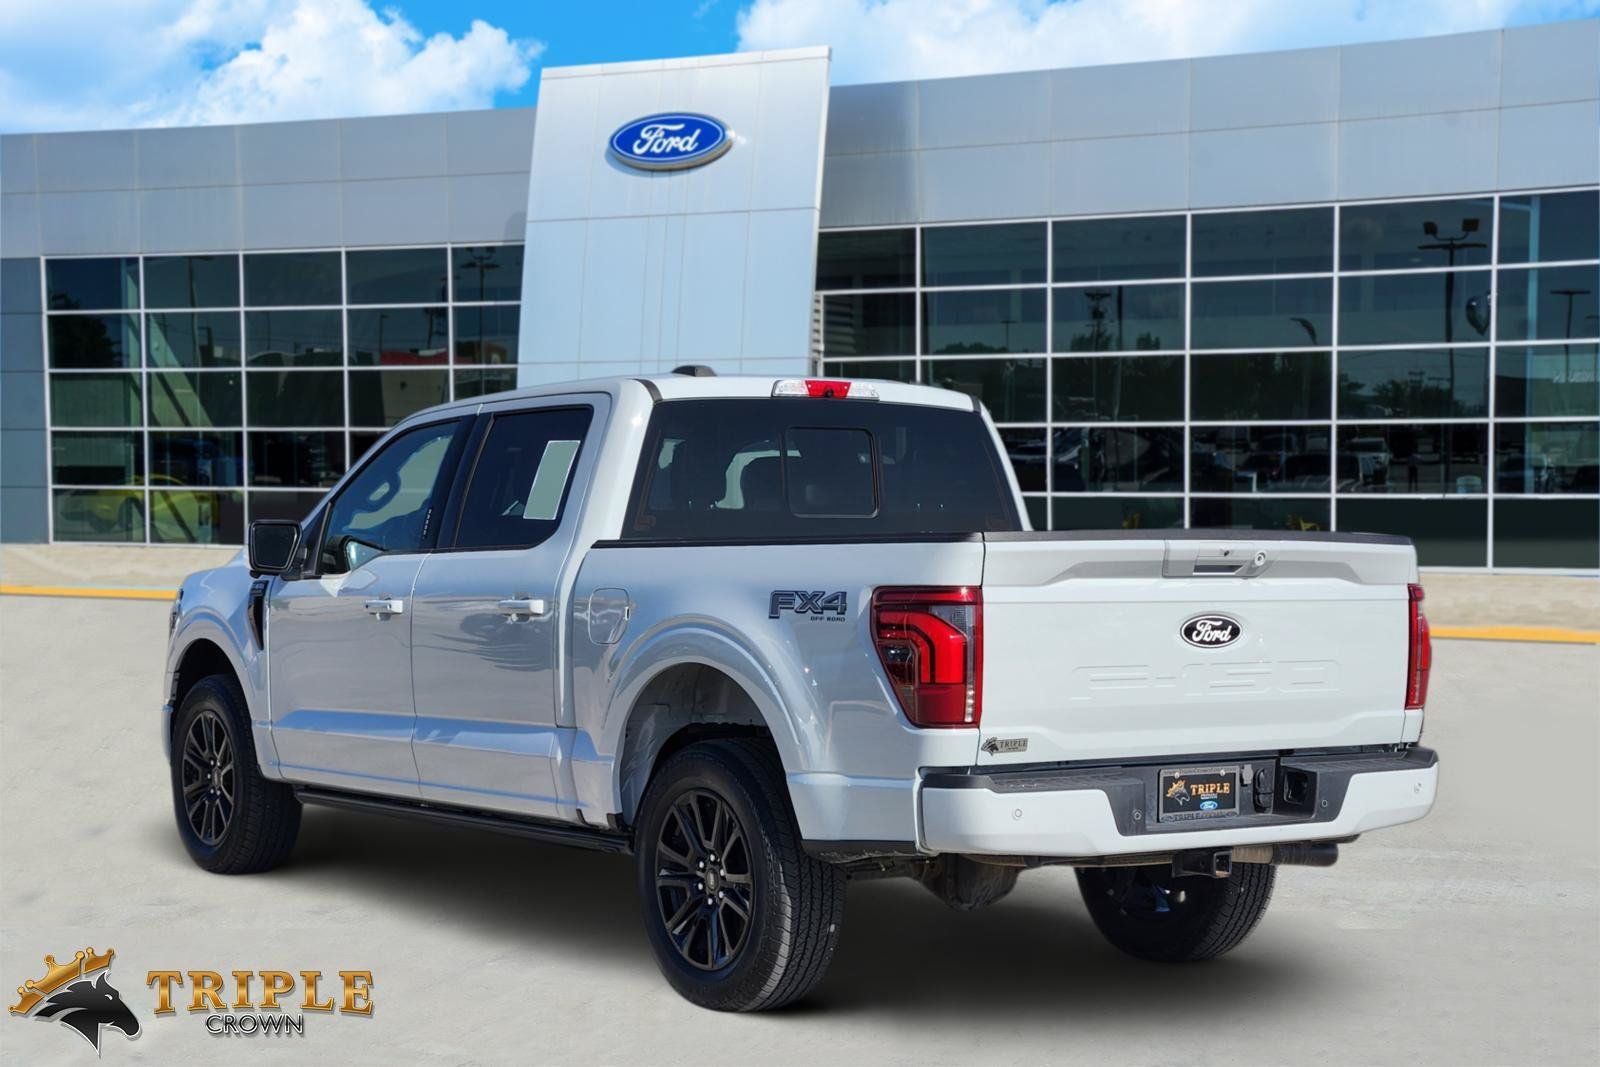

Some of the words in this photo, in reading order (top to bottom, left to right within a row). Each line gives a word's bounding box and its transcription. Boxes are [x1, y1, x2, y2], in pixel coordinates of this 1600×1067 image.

[632, 123, 701, 155] Ford
[768, 590, 847, 619] FX4
[1192, 620, 1232, 642] Ford
[1190, 782, 1230, 796] TRIPLE
